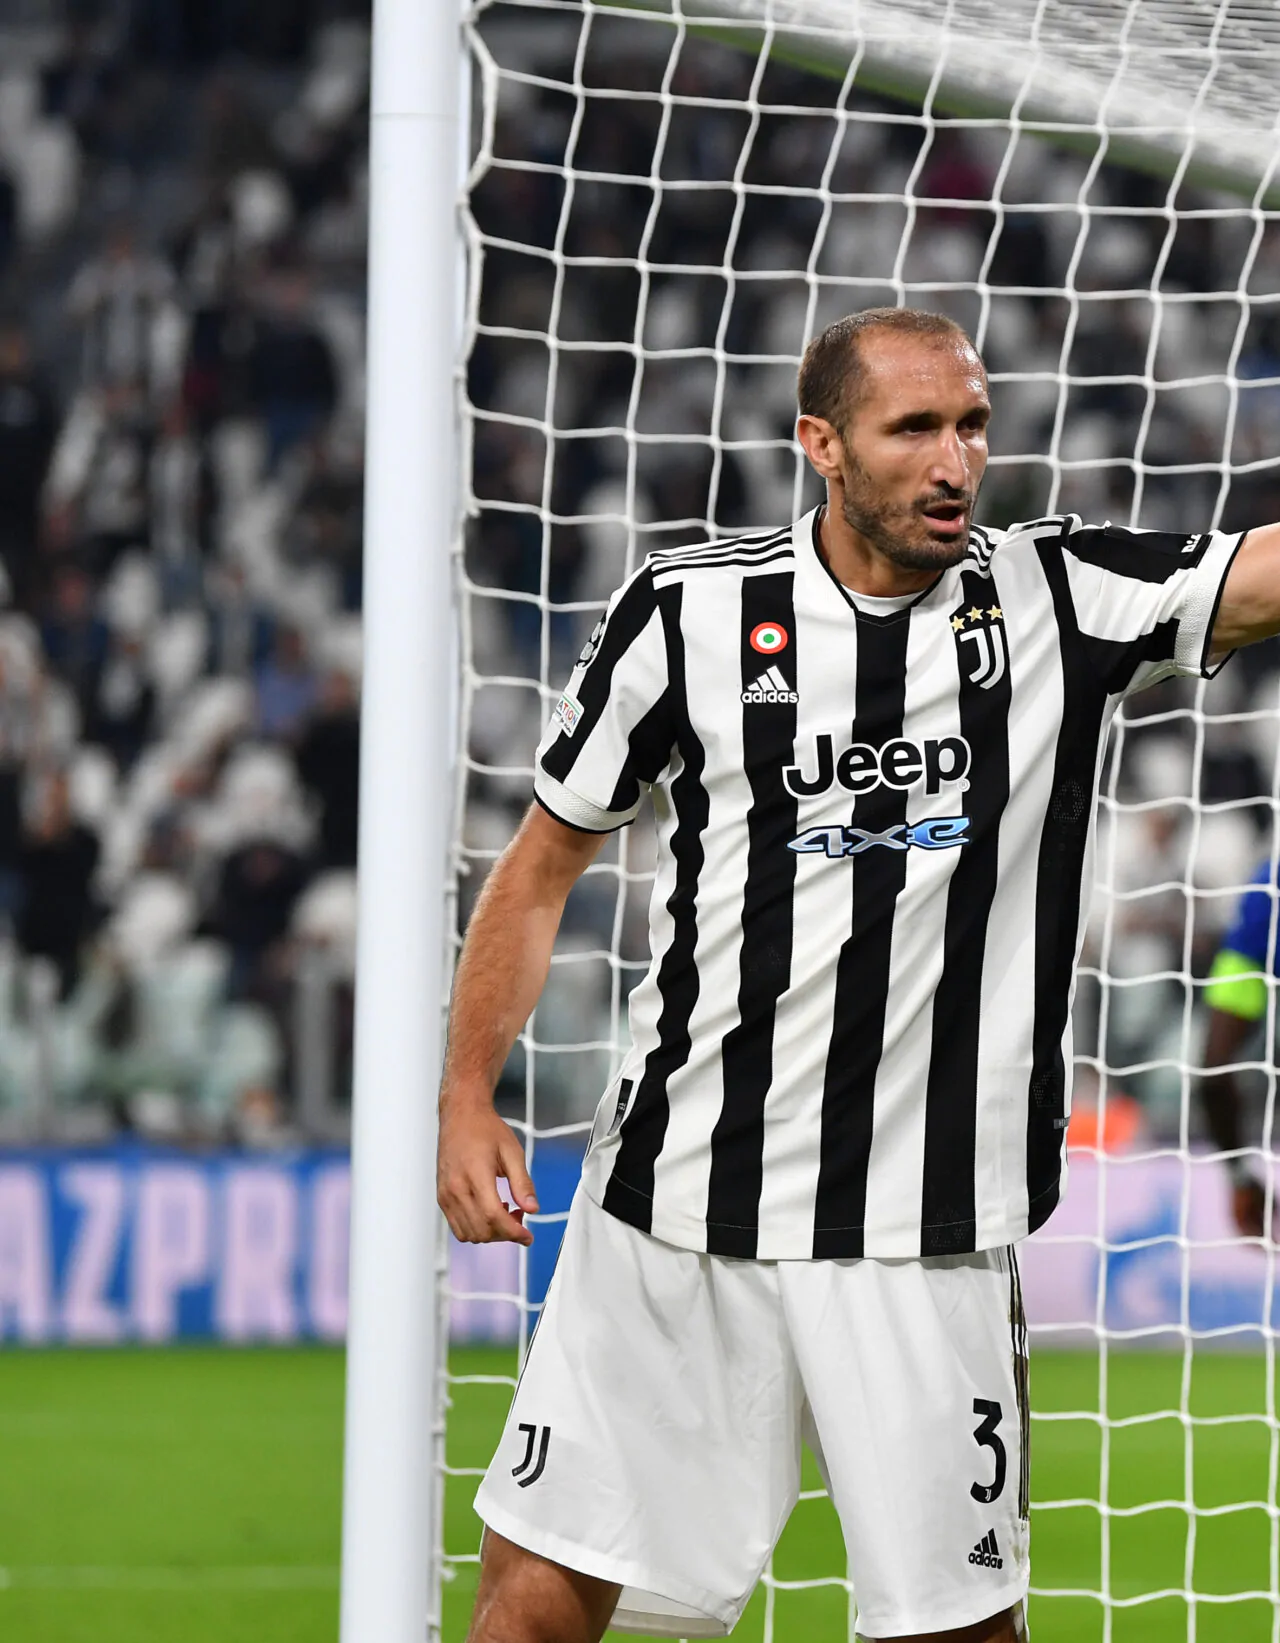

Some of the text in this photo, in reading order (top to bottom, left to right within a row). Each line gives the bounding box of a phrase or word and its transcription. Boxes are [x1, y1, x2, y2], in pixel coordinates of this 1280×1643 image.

[741, 689, 799, 704] adidas
[783, 731, 972, 799] Jeep
[970, 1398, 1007, 1503] 3
[968, 1551, 1003, 1570] adidas
